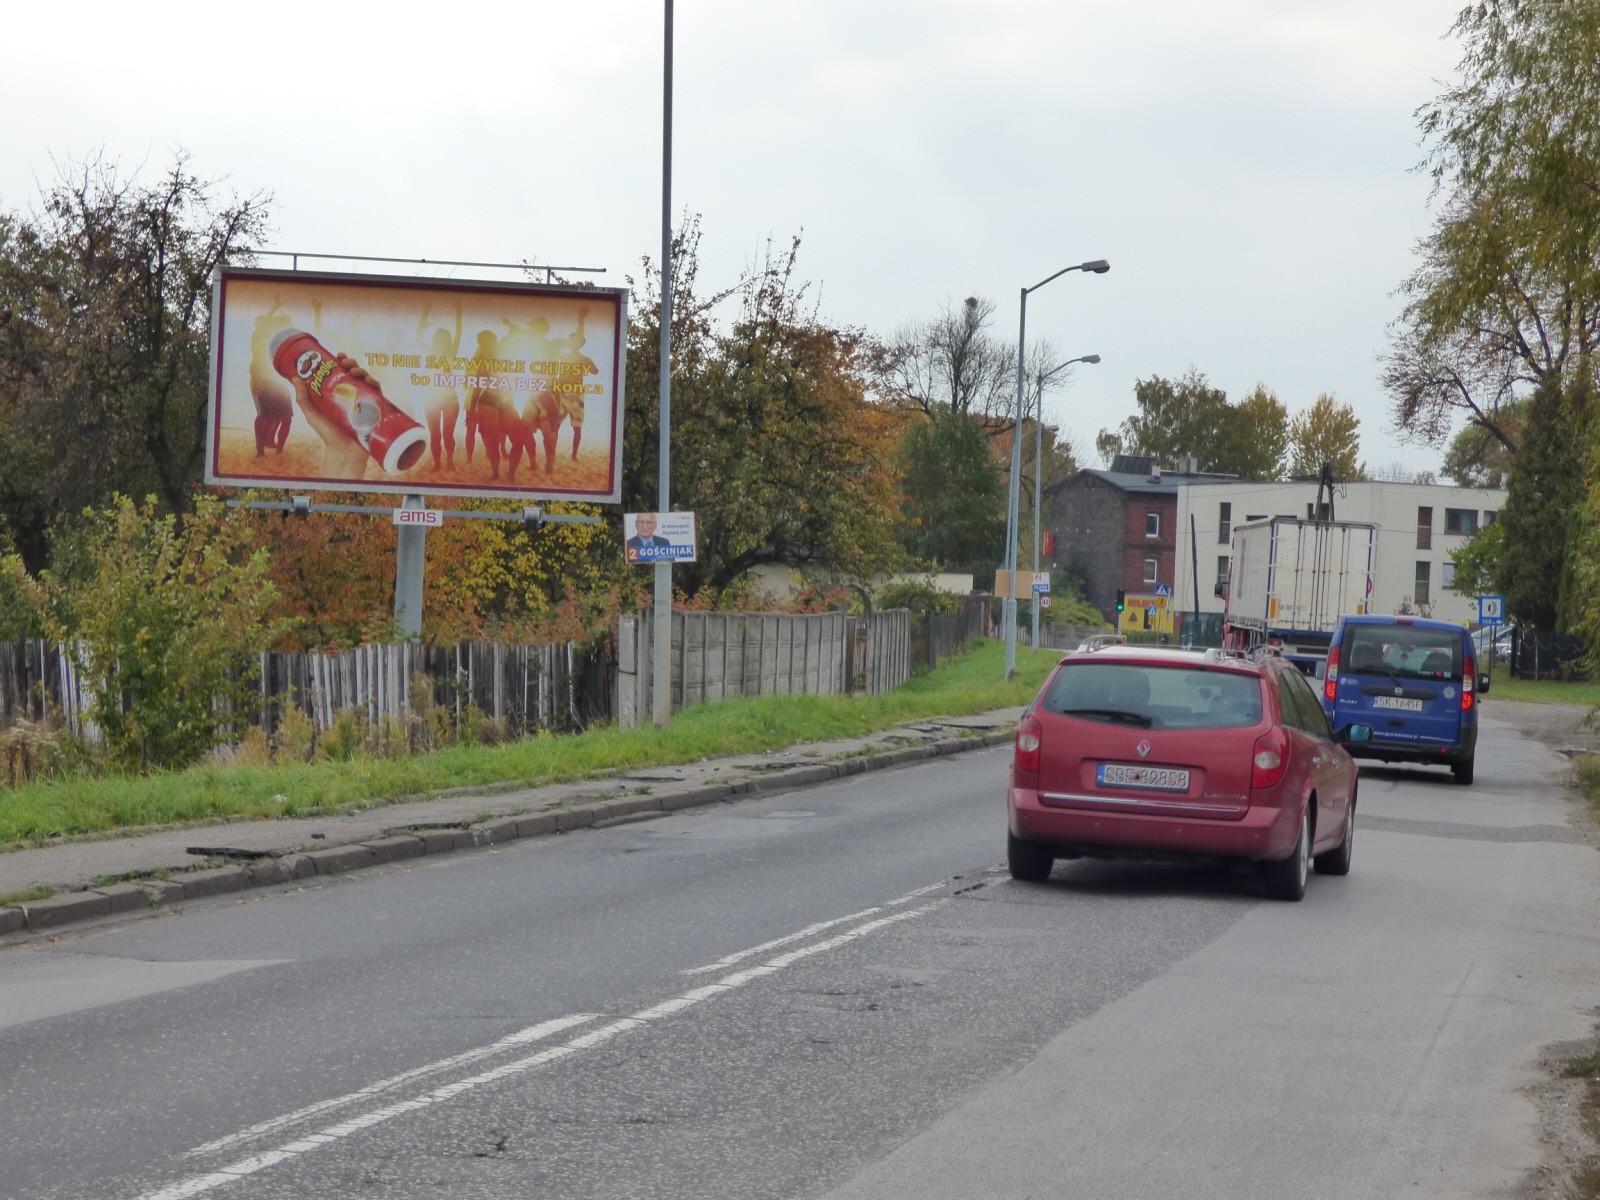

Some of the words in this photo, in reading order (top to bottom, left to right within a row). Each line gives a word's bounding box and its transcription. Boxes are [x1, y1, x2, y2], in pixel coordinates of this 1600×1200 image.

[365, 352, 388, 367] TO
[392, 354, 421, 369] NIE
[425, 355, 451, 373] SĄ
[454, 357, 525, 373] ZWYKŁE
[530, 360, 593, 377] CHIPSY
[411, 373, 431, 386] to
[433, 374, 511, 390] IMPREZA
[515, 377, 547, 391] BEZ
[553, 380, 604, 395] końca
[400, 511, 436, 523] ams
[629, 549, 637, 560] 2
[640, 545, 693, 556] GOŚCINIAK
